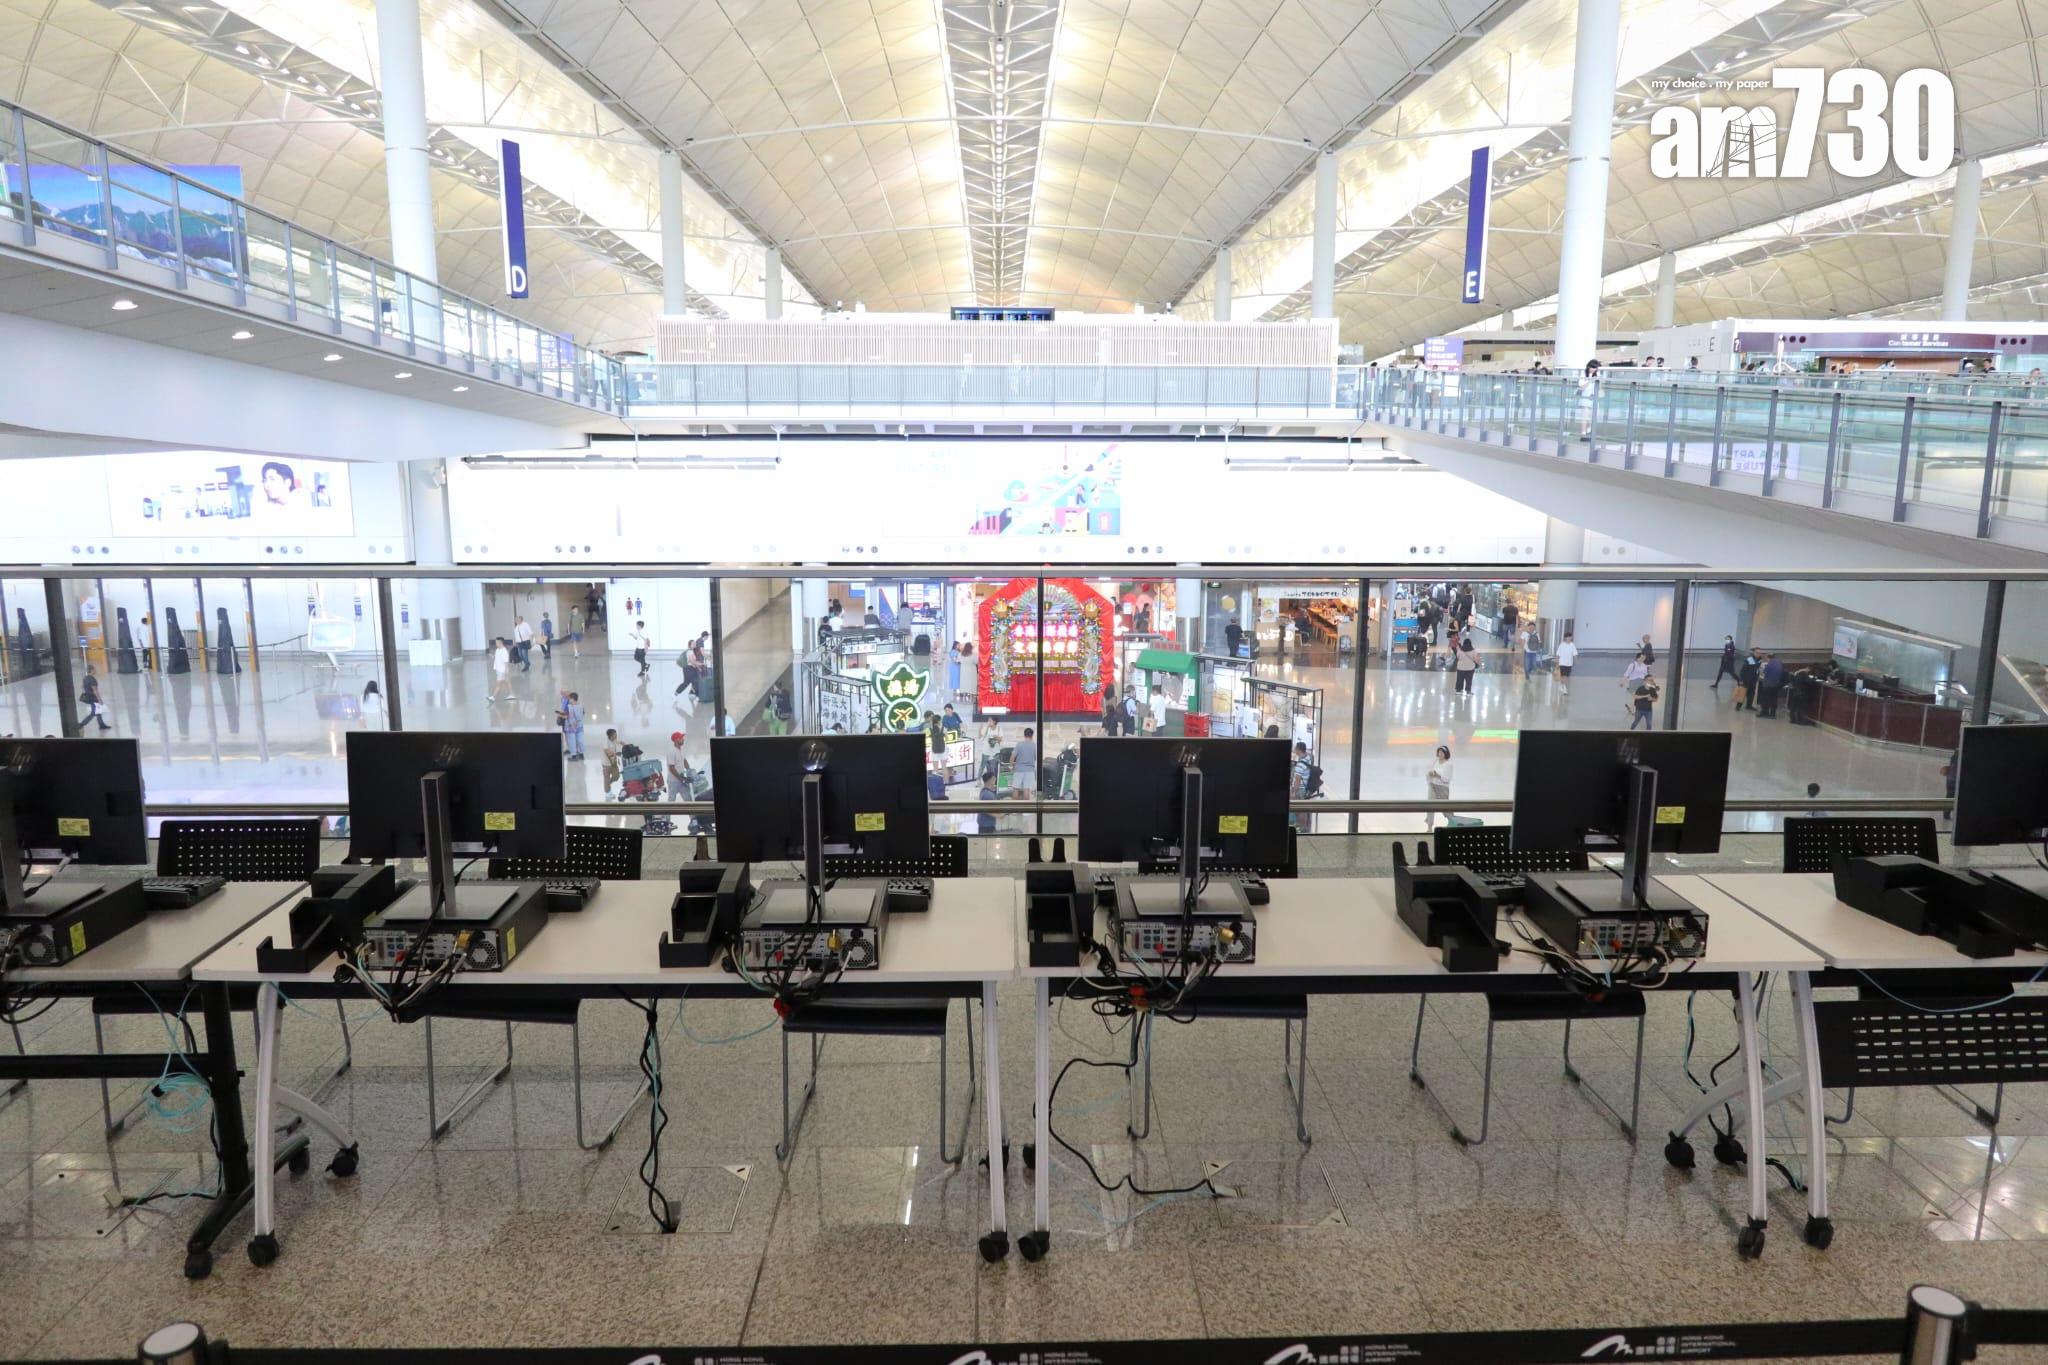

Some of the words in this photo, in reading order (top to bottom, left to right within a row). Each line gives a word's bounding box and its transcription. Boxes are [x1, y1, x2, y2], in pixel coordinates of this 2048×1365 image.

[512, 265, 527, 293] D
[1465, 271, 1478, 298] E
[1709, 336, 1716, 352] E
[12, 746, 31, 772] hp
[439, 743, 461, 766] hp
[808, 743, 827, 767] hp
[1178, 745, 1197, 768] hp
